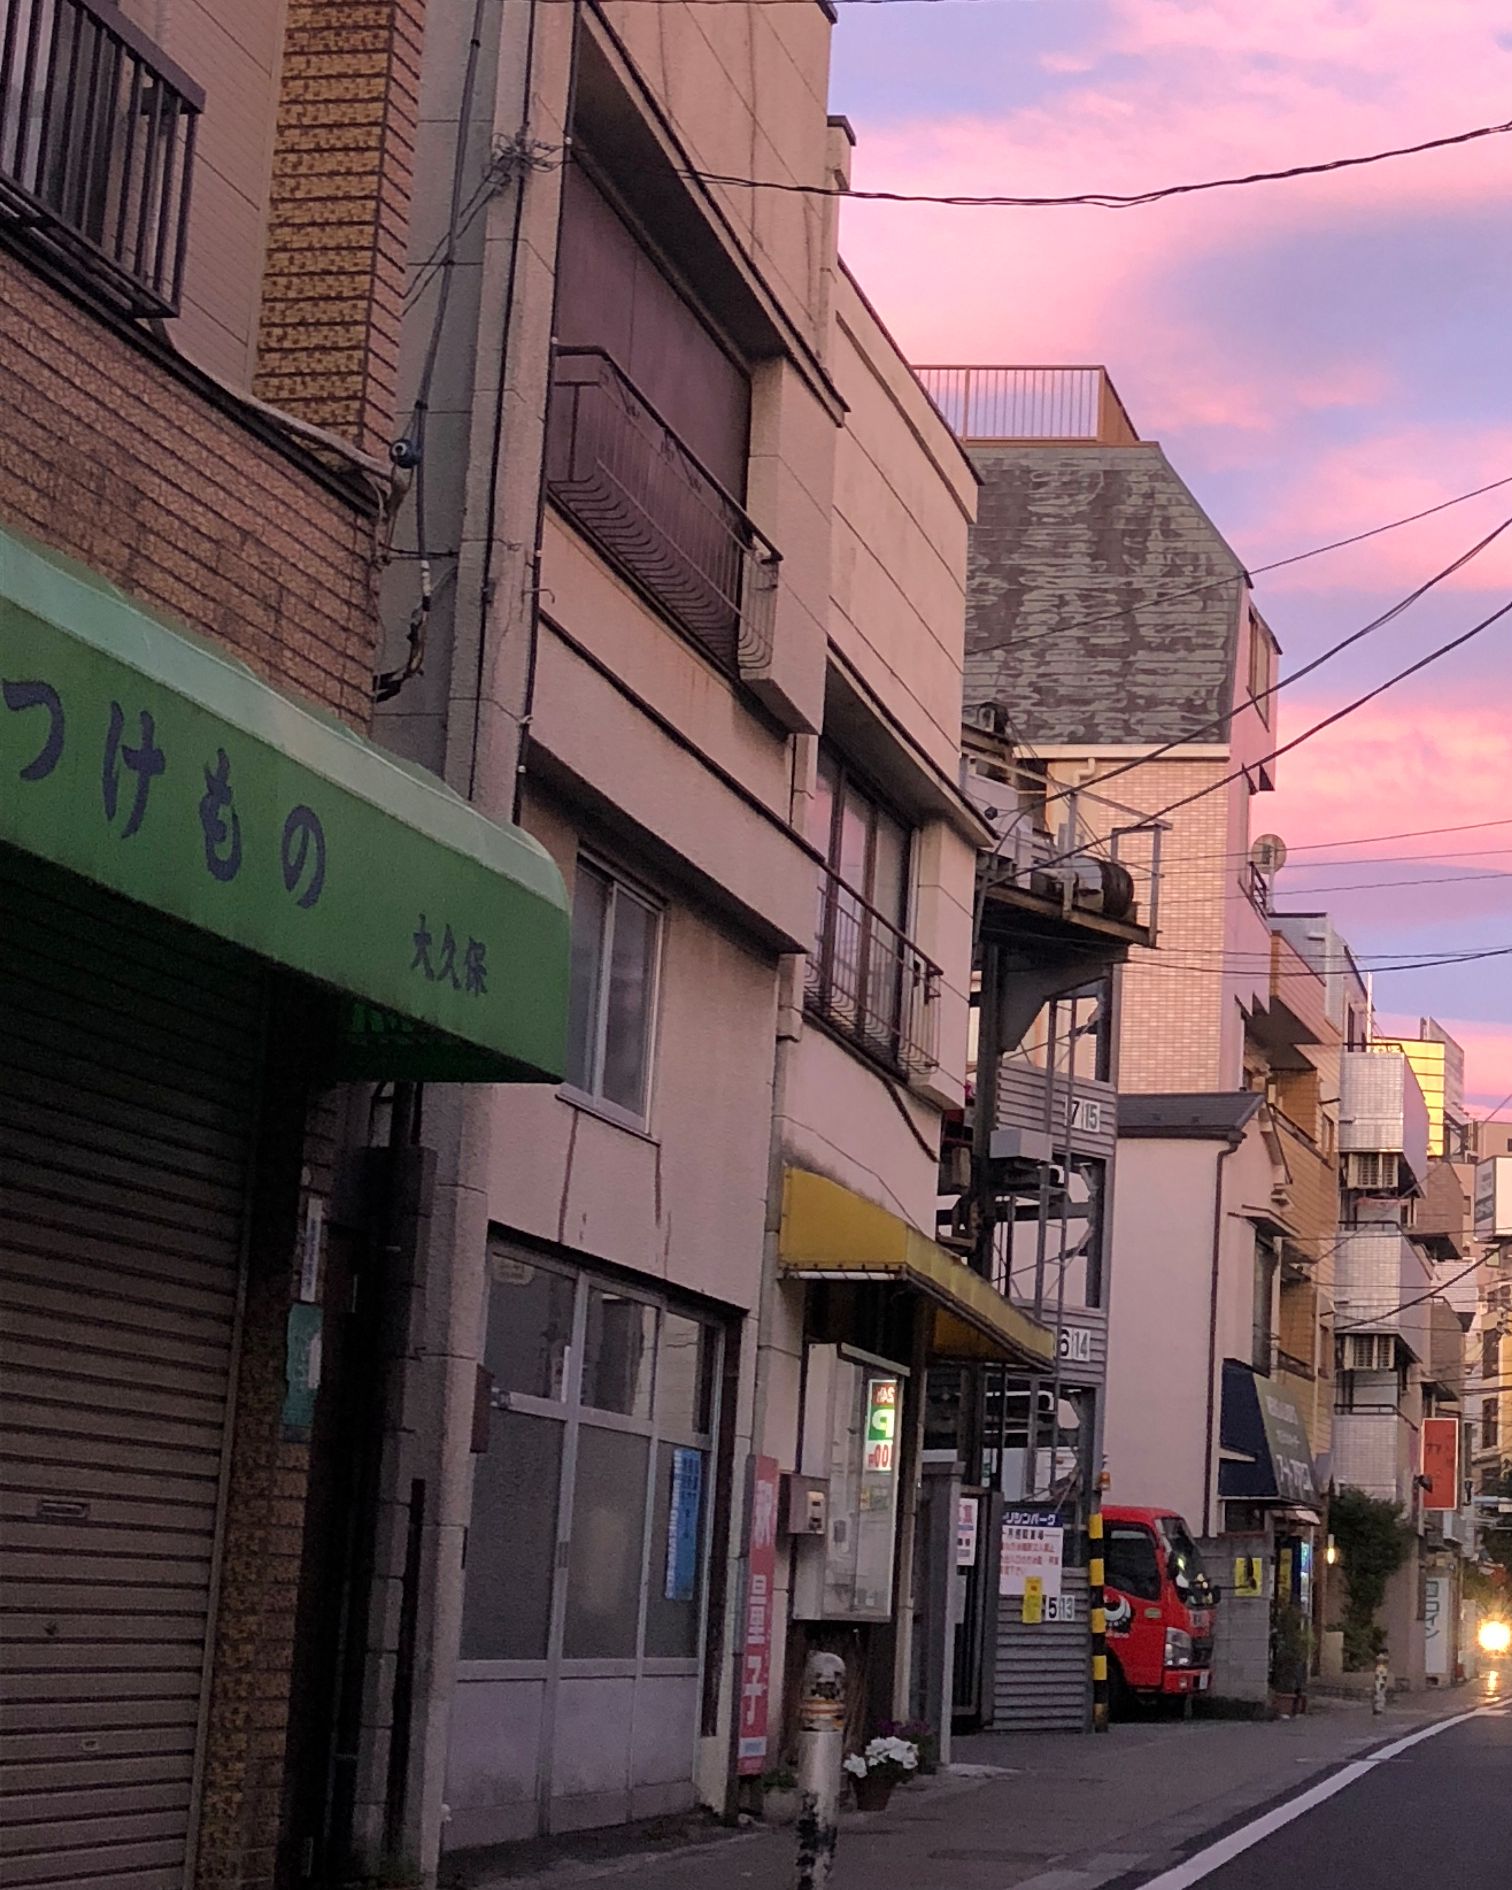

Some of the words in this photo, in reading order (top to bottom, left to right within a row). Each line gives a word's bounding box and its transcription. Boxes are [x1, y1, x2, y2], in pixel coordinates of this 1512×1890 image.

[1, 678, 326, 909] つけもの
[411, 913, 488, 998] 大久保
